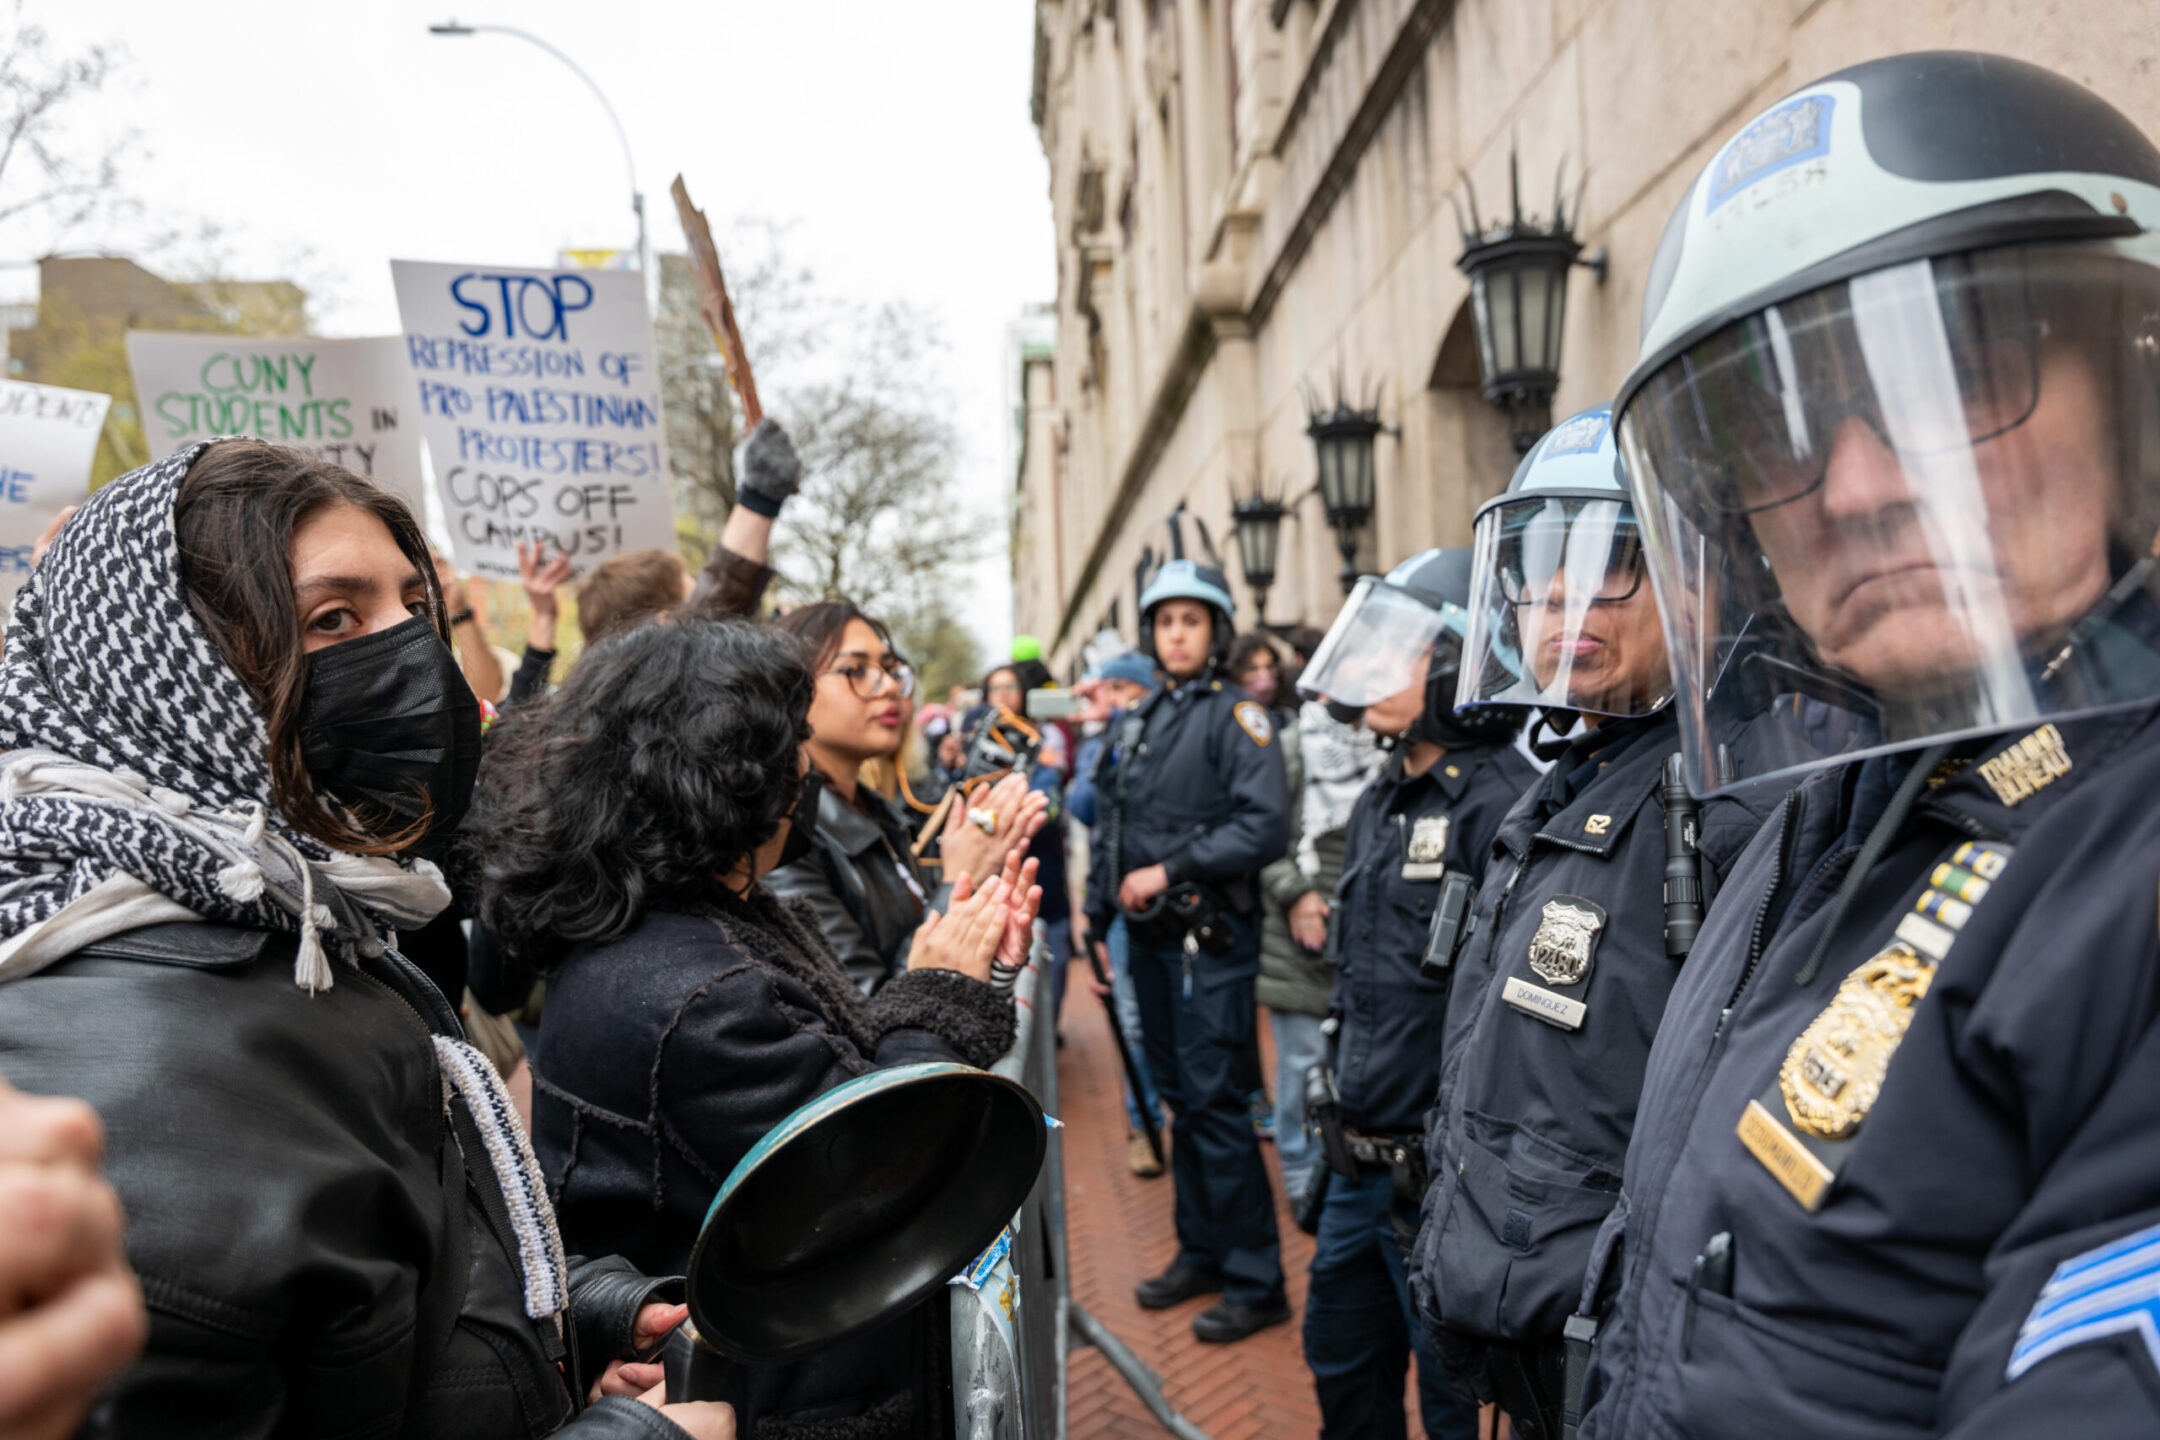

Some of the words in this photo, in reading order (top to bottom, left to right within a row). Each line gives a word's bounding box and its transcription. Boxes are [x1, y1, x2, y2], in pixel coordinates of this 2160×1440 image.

[450, 273, 595, 341] STOP
[201, 353, 316, 396] CUNY
[408, 334, 585, 379] REPRESSION
[599, 352, 643, 386] OF
[154, 391, 354, 439] STUDENTS
[372, 407, 397, 432] IN
[458, 426, 661, 482] PROTESTERS!
[447, 466, 543, 518] COPS
[555, 484, 638, 519] OFF
[1516, 988, 1568, 1015] DOMINGUEZ
